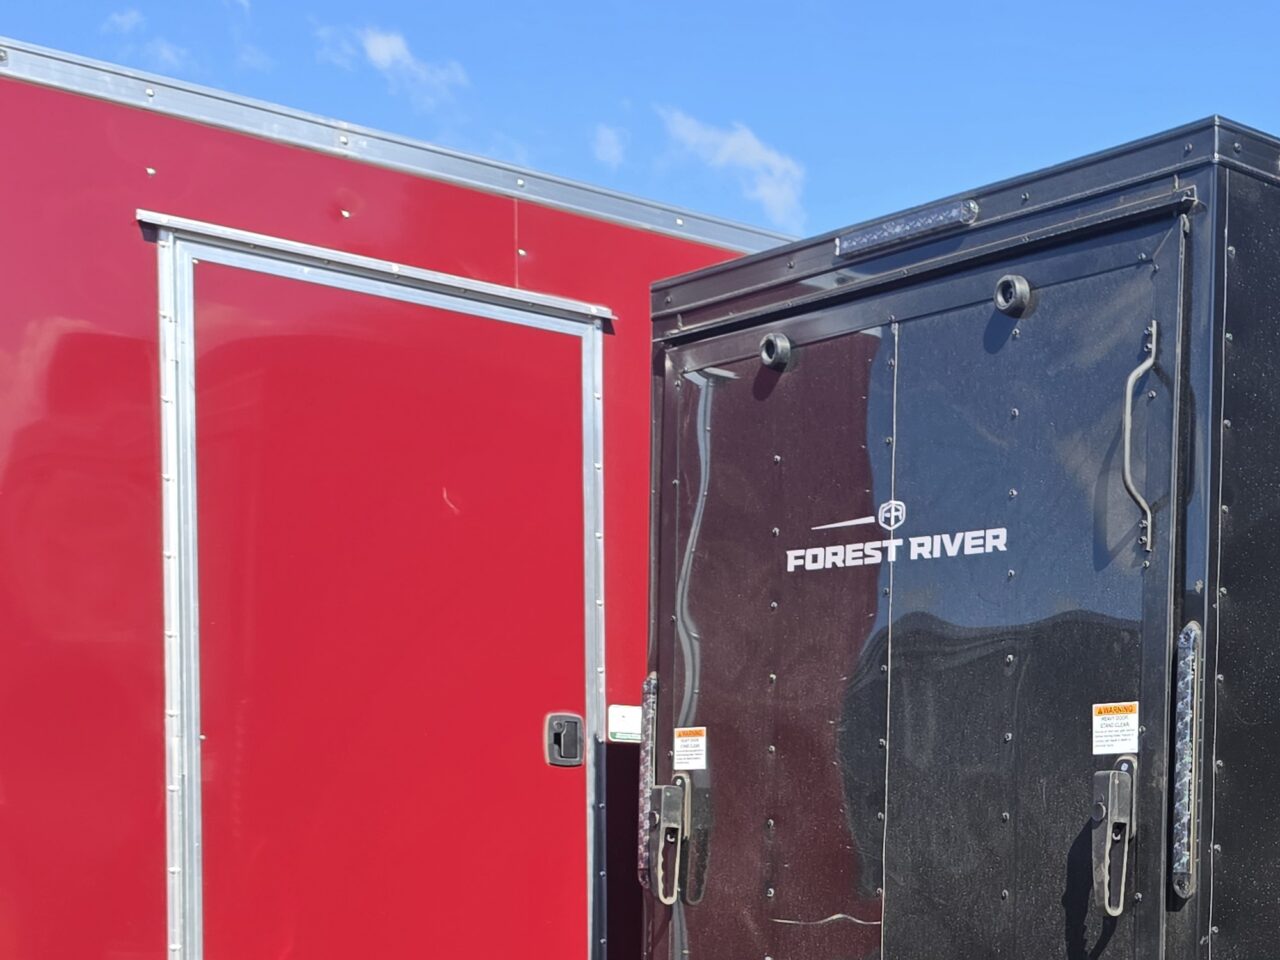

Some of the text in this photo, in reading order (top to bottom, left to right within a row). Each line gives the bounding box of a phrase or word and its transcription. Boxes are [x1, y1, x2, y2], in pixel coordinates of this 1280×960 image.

[786, 528, 1007, 572] FOREST RIVER
[1103, 705, 1134, 714] WARNING
